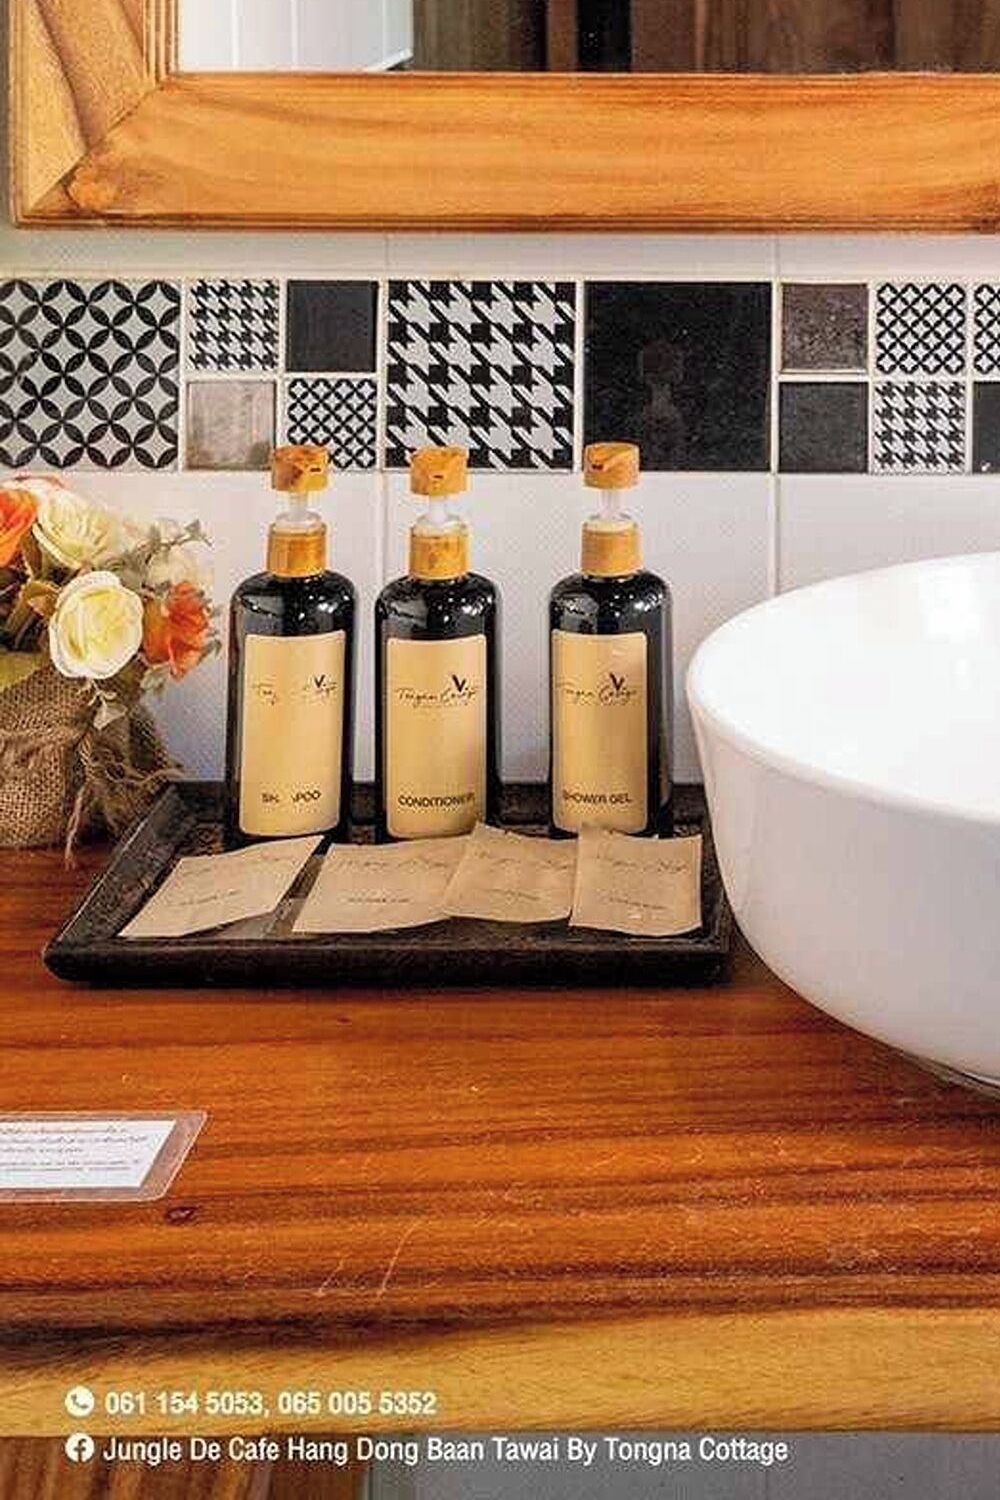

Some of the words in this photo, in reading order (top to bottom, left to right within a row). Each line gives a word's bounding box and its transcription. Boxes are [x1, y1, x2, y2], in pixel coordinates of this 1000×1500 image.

[260, 789, 322, 804] SHPOO
[397, 792, 476, 808] CONDITIONER
[608, 791, 633, 805] GEL
